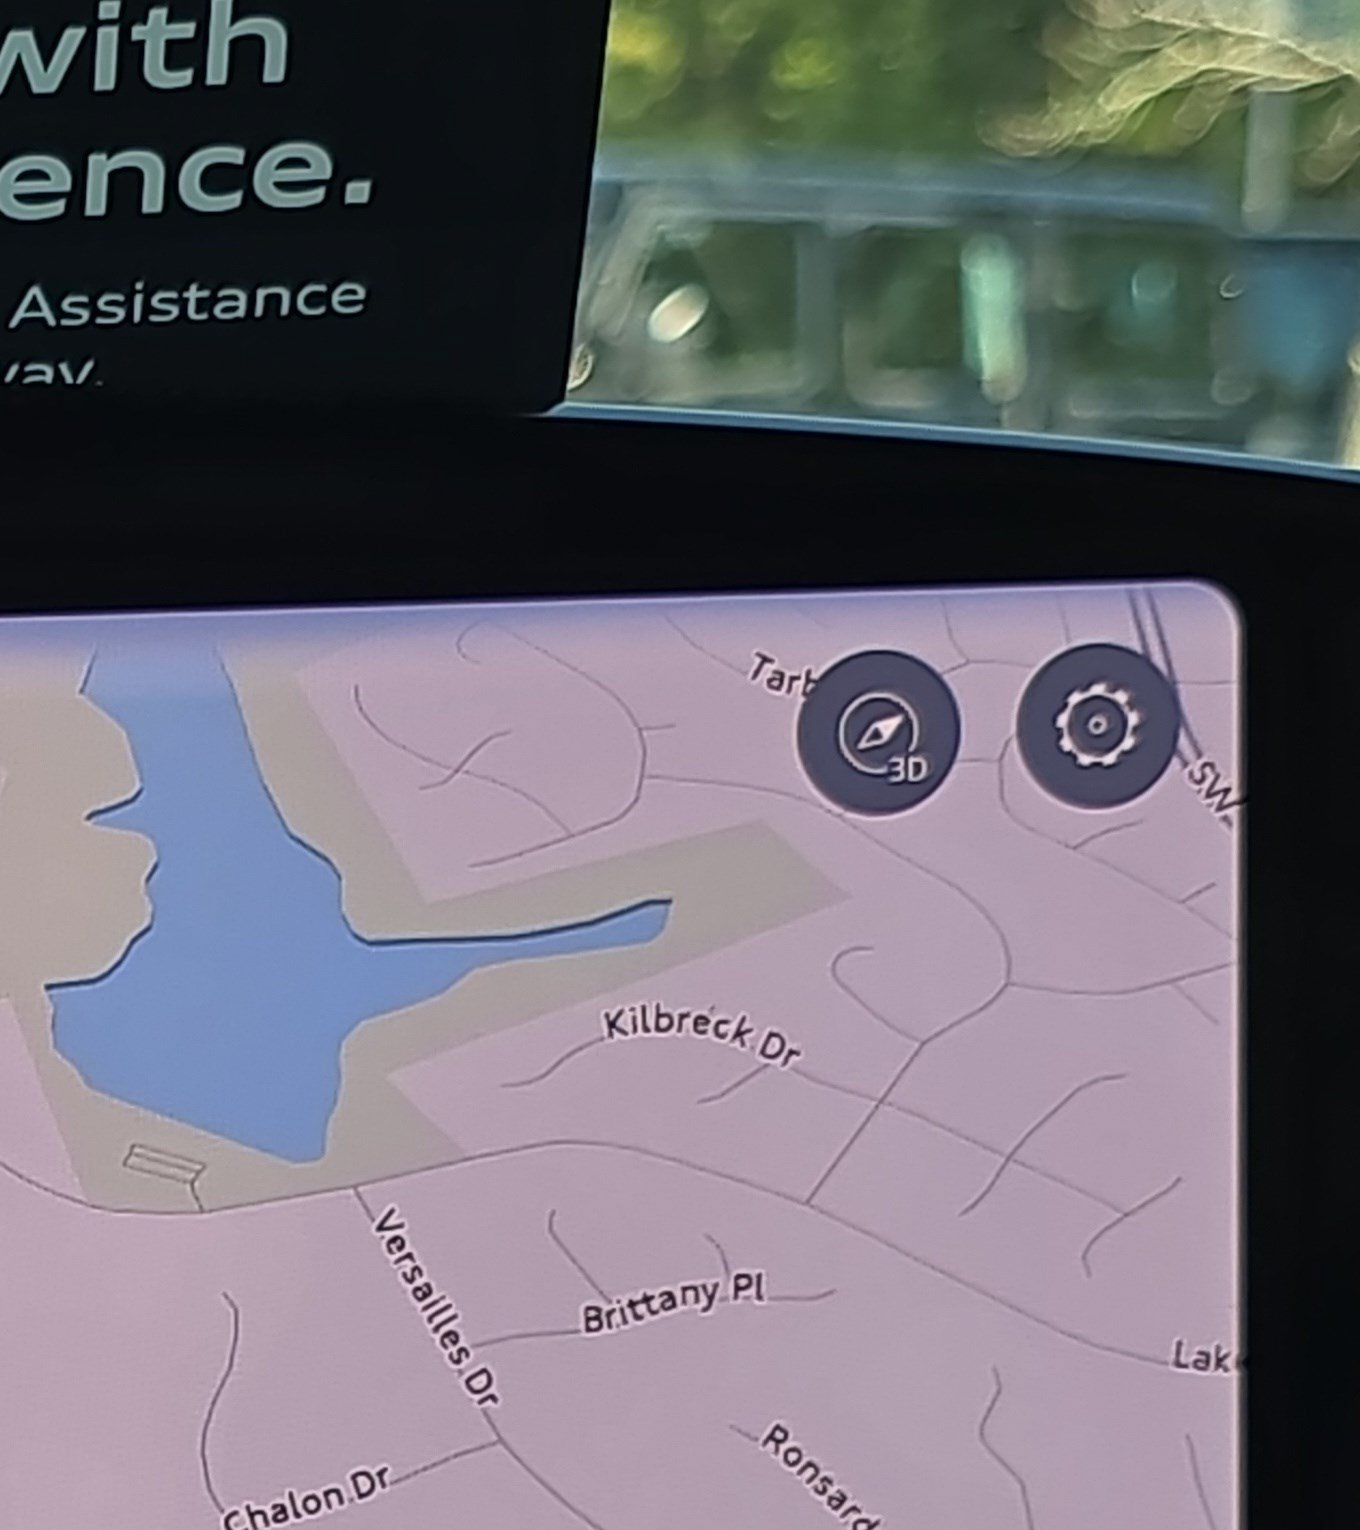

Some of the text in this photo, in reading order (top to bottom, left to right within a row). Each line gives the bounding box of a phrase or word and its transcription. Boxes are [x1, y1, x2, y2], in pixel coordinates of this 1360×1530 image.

[8, 278, 369, 330] Assistance
[887, 756, 928, 783] 3D
[603, 1002, 801, 1067] Kilbreck Dr
[375, 1208, 500, 1408] Versailles Dr
[583, 1271, 764, 1333] Brittany Pl
[351, 1466, 390, 1501] Dr
